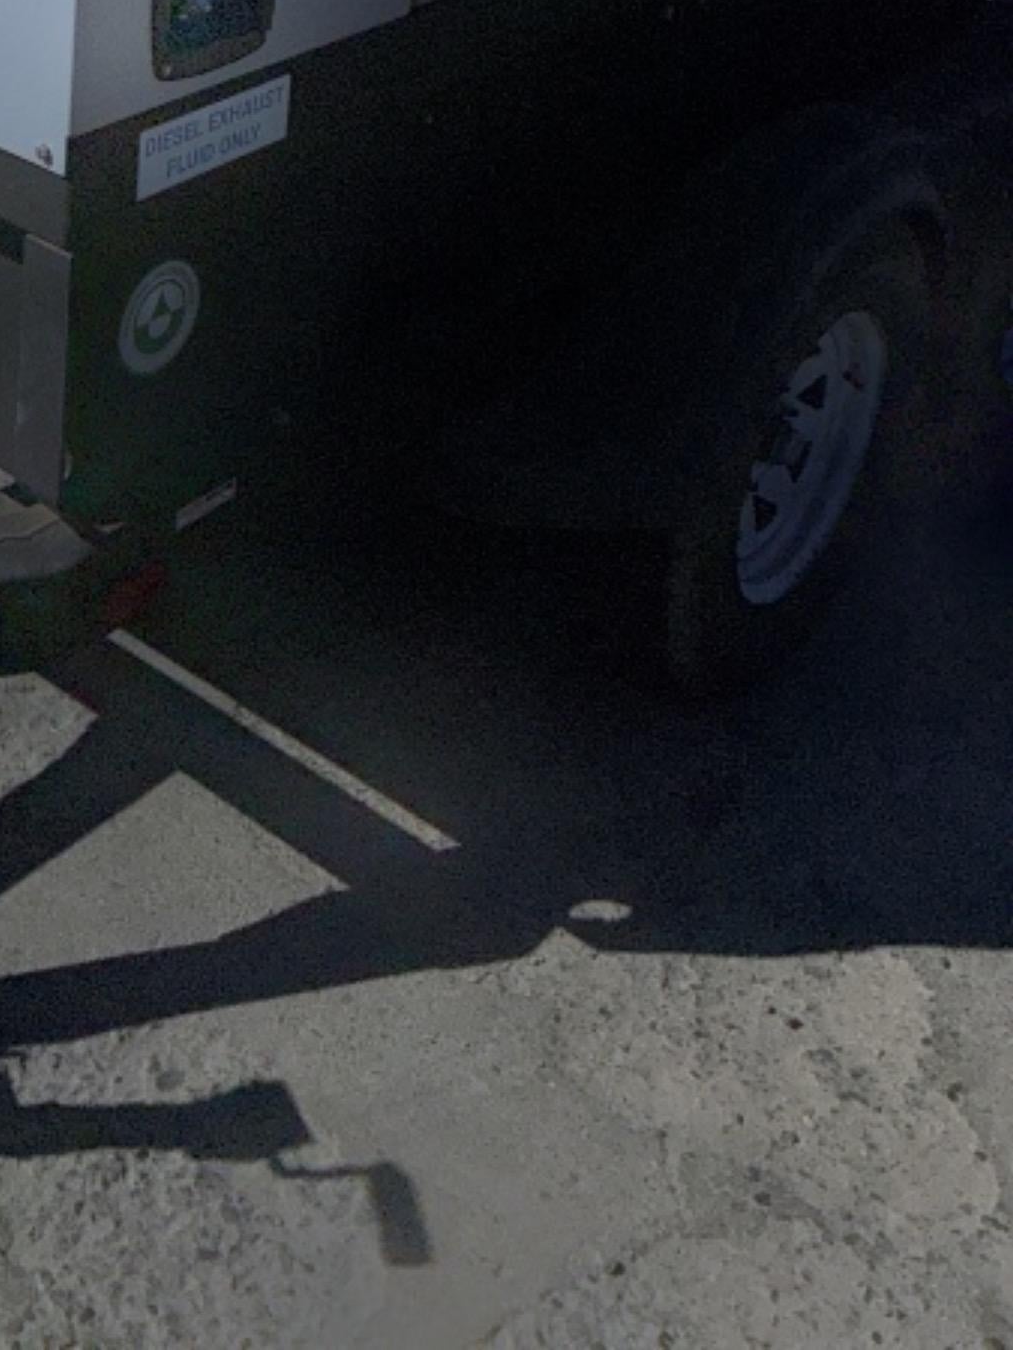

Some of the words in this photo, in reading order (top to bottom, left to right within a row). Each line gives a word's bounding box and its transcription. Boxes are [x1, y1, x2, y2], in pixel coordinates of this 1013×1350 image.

[146, 122, 204, 157] DIESEL
[208, 87, 283, 132] EXHAUST
[167, 144, 216, 179] FLUID
[220, 122, 262, 155] ONLY
